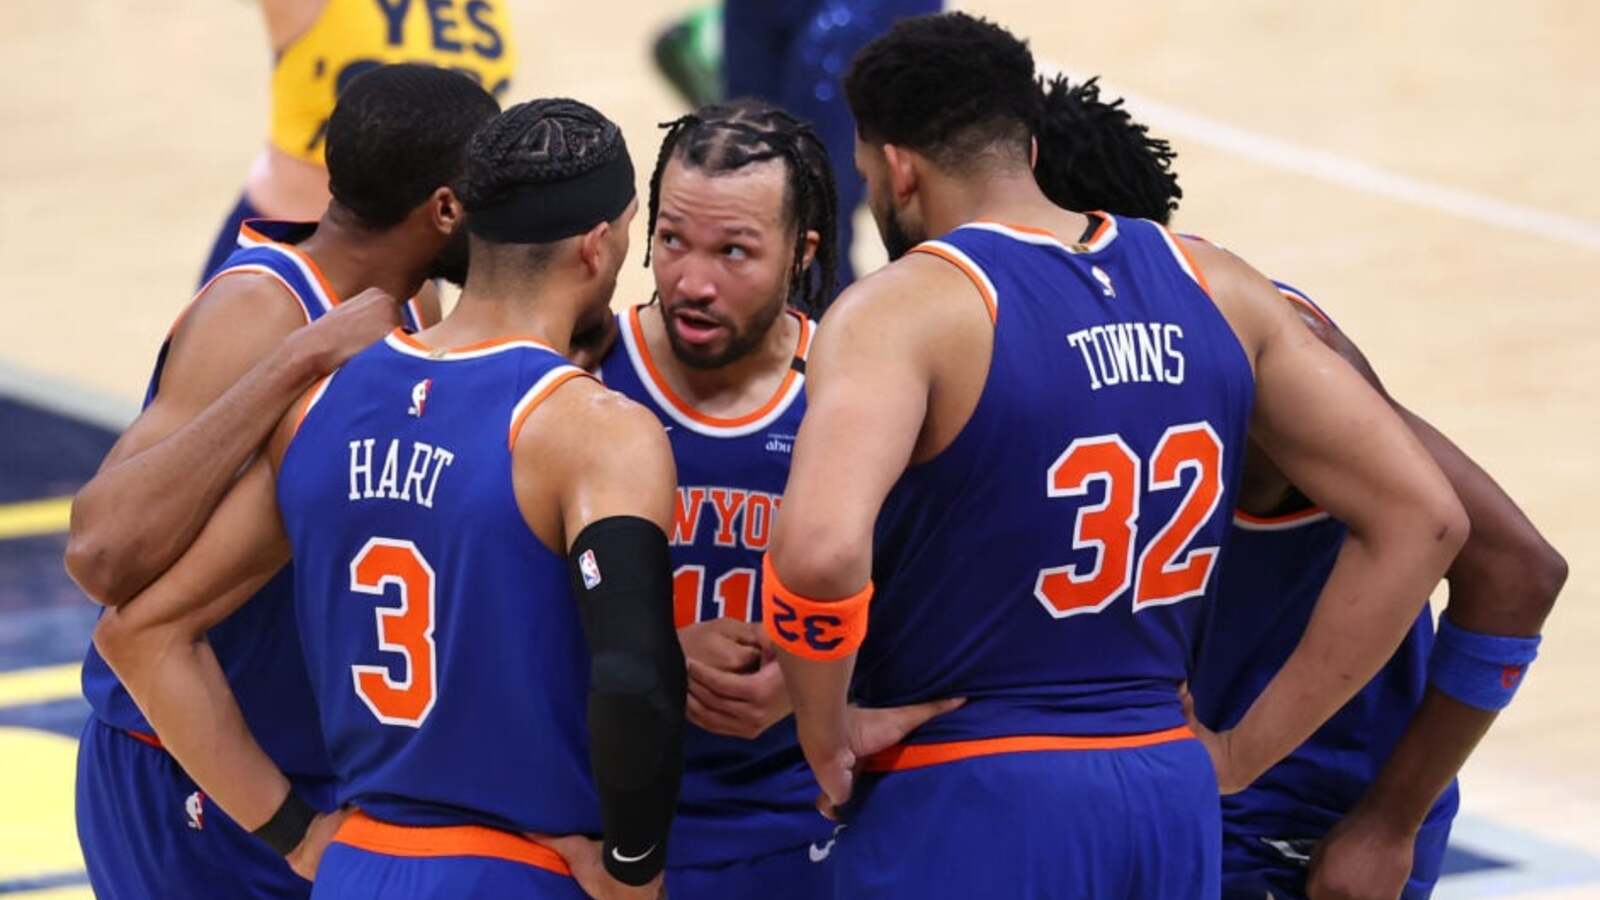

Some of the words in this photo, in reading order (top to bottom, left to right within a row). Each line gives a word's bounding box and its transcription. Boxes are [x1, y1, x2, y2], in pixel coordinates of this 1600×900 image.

[375, 0, 504, 59] YES
[1067, 322, 1184, 390] TOWNS
[349, 438, 454, 508] HART
[708, 486, 783, 552] YO
[1034, 421, 1224, 619] 32
[350, 536, 437, 728] 3
[773, 594, 845, 651] 32
